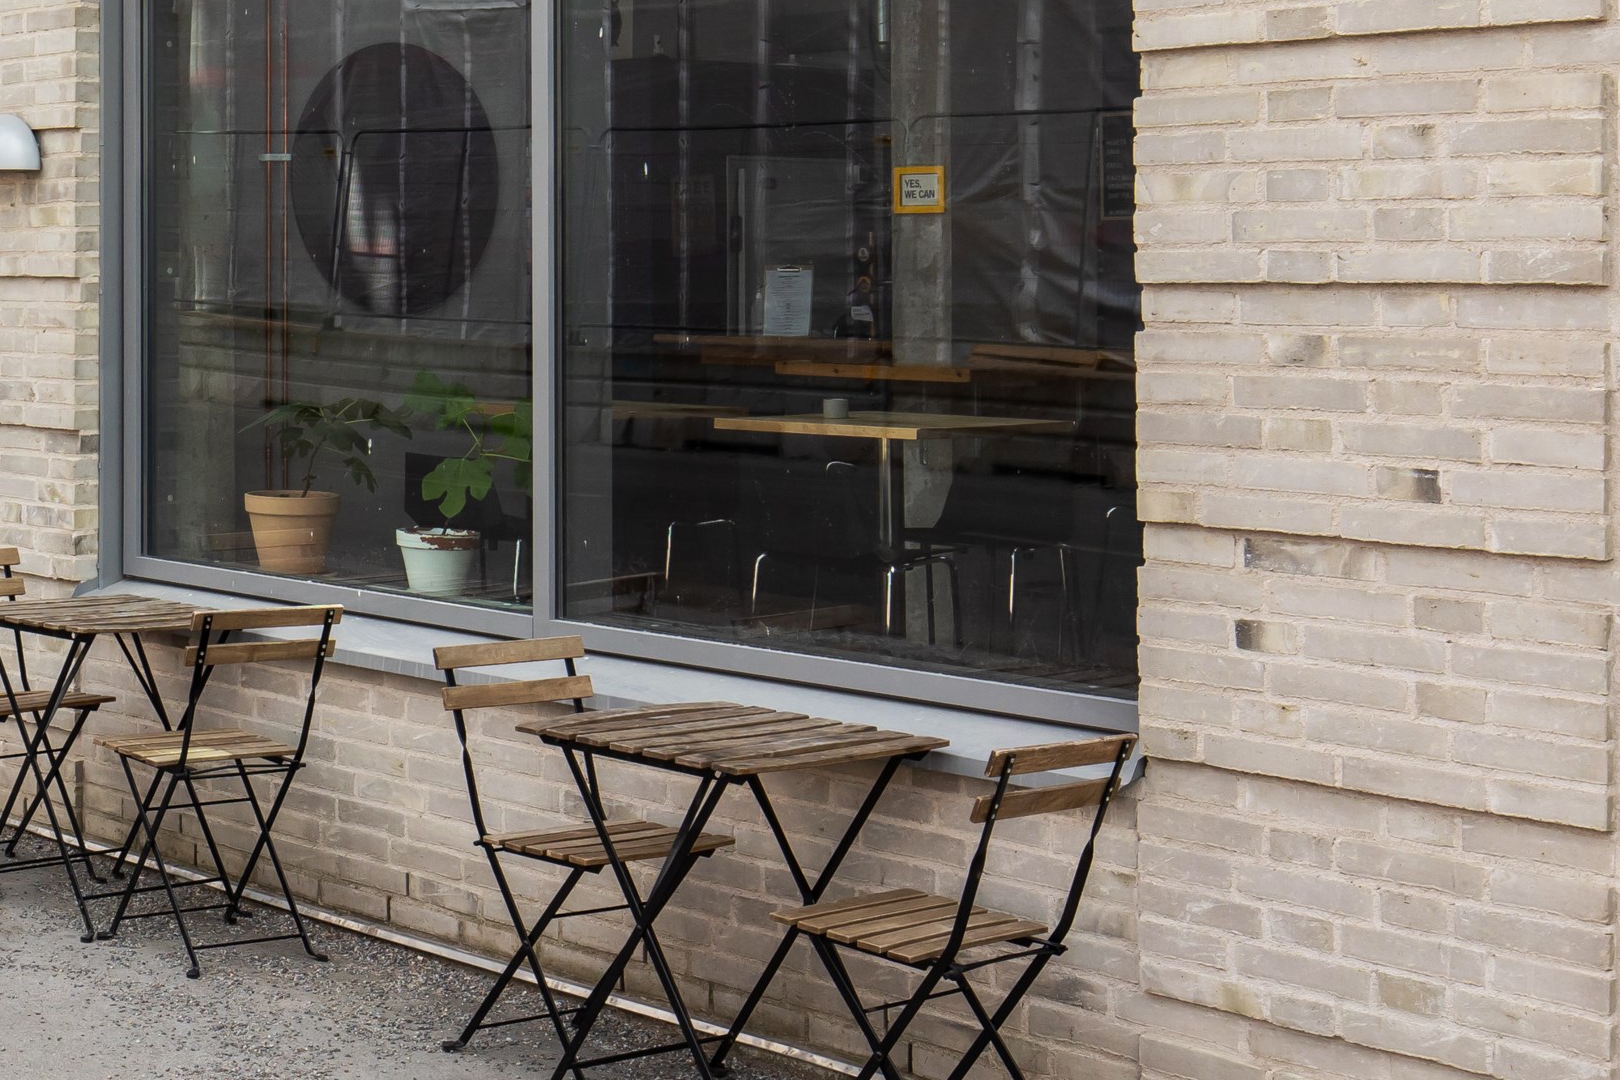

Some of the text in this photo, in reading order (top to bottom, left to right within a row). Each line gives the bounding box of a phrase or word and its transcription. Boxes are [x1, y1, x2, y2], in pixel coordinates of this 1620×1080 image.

[904, 179, 922, 189] YES,
[904, 189, 935, 199] WE CAN
